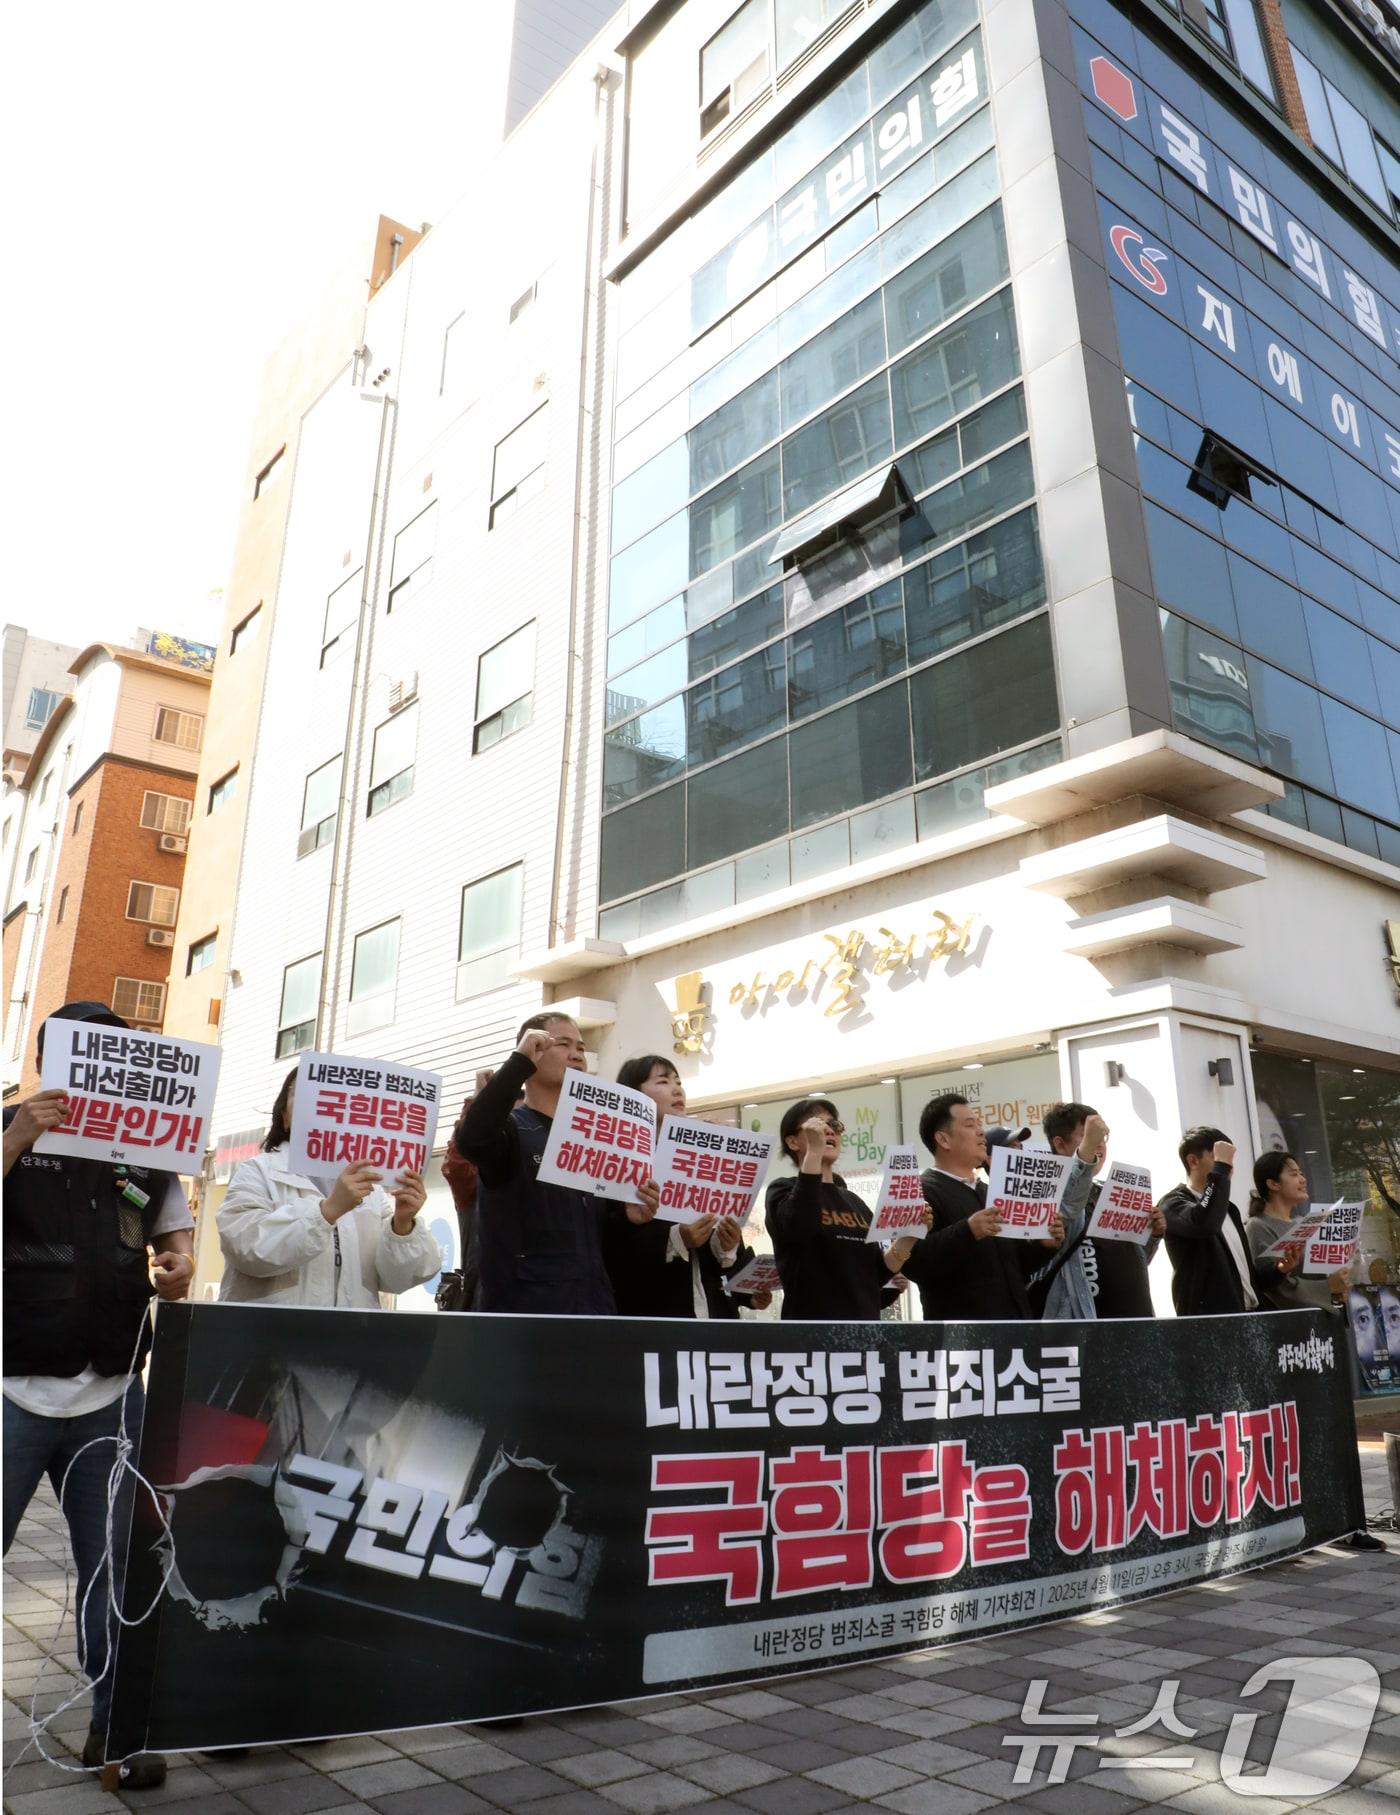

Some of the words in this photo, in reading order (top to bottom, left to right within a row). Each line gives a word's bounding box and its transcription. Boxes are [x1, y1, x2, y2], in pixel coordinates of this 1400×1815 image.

[779, 47, 979, 244] 국민의힘
[1161, 105, 1388, 349] 국민의힘
[71, 1031, 201, 1076] 내란정당이
[69, 1062, 197, 1108] 대선출마가
[308, 1063, 382, 1089] 내란정당
[386, 1073, 437, 1102] 범죄소굴
[568, 1080, 621, 1111] 내란정당
[316, 1090, 428, 1136] 국힘당을
[571, 1106, 651, 1155] 국힘당을
[856, 1107, 878, 1126] My
[306, 1129, 427, 1175] 해체하자!
[668, 1126, 725, 1151] 내란정당
[726, 1137, 771, 1159] 범죄소굴
[841, 1128, 874, 1146] ecial
[857, 1144, 887, 1165] Day
[671, 1148, 759, 1188] 국힘당을
[1006, 1154, 1064, 1179] 내란정당이
[1111, 1168, 1138, 1186] 내란정당
[660, 1179, 752, 1217] 해체하자!
[1003, 1176, 1058, 1199] 대선출마가
[1109, 1185, 1153, 1213] 국힘당을
[1097, 1209, 1149, 1234] 해체하자!
[643, 1350, 886, 1430] 내란정당
[899, 1346, 1082, 1422] 범죄소굴
[643, 1440, 1033, 1607] 국힘당을
[1053, 1400, 1302, 1556] 해체하자!
[753, 1624, 825, 1657] 내란정당
[831, 1613, 897, 1646] 범죄소굴
[900, 1604, 946, 1634] 국힘당
[950, 1598, 979, 1624] 해체
[983, 1587, 1037, 1618] 기자회견
[1047, 1578, 1089, 1604] 2025년
[1090, 1574, 1110, 1595] 4월
[1112, 1565, 1150, 1590] 11일(금)
[1151, 1560, 1173, 1580] 오후
